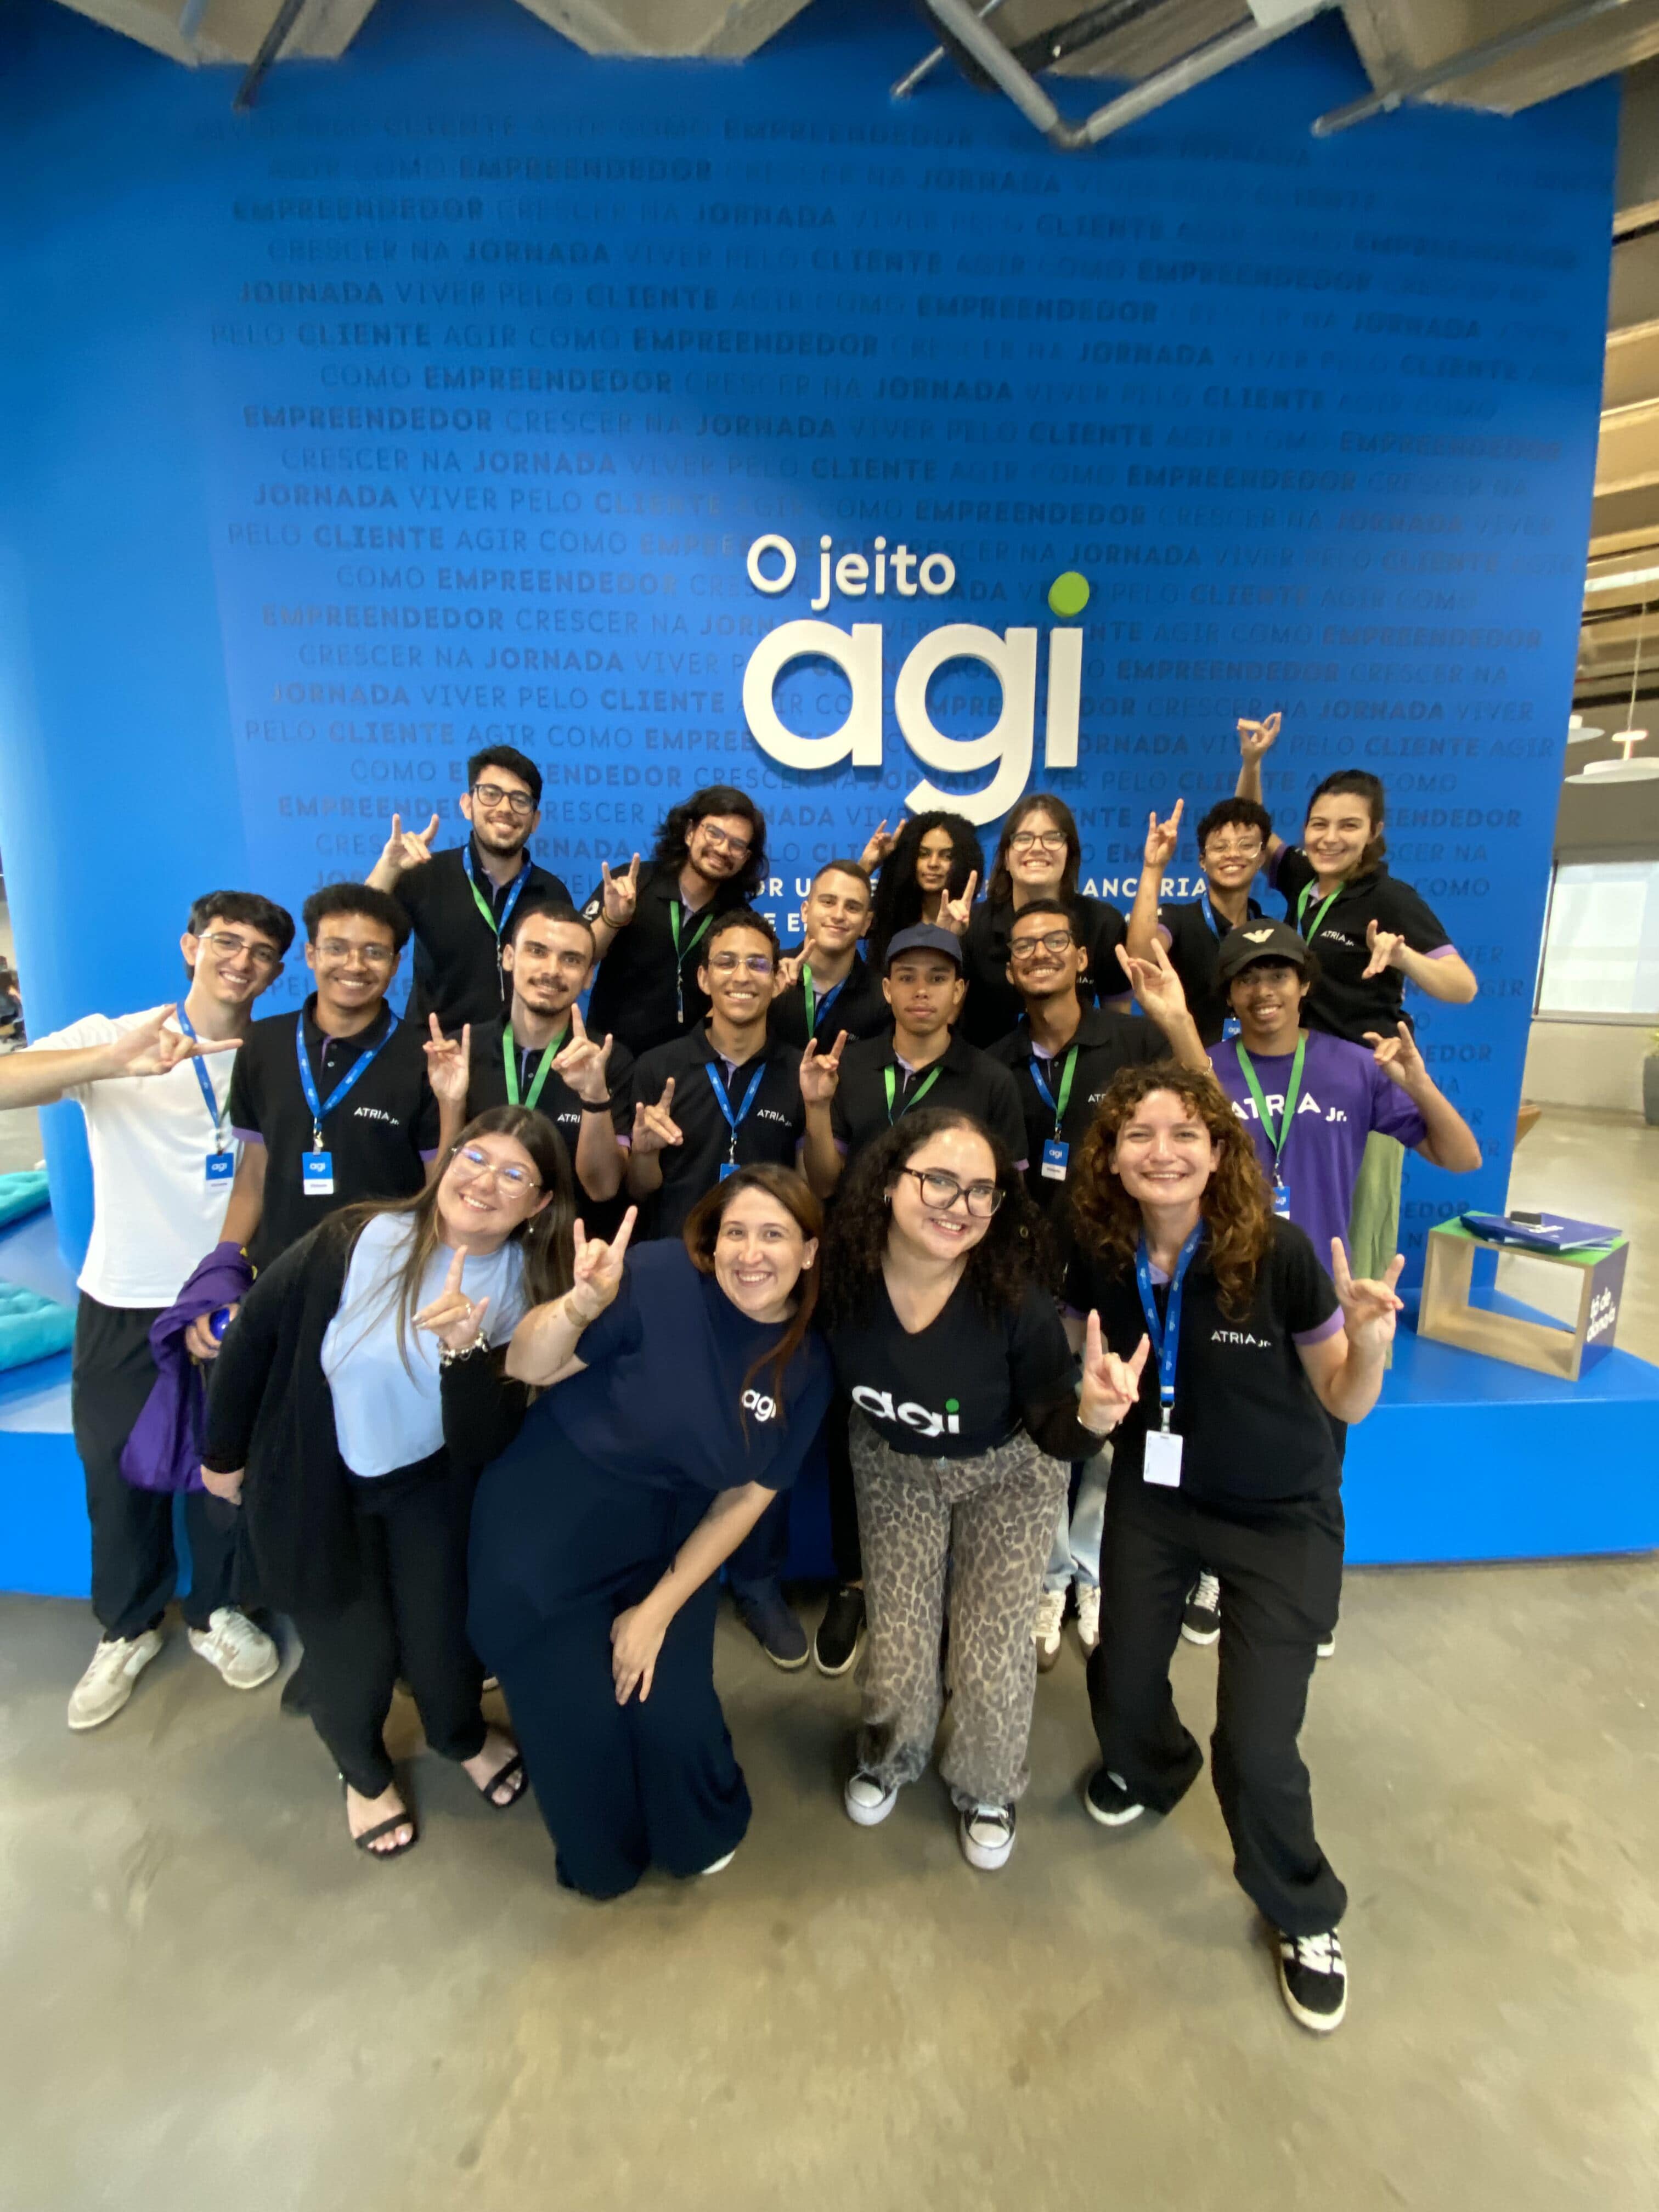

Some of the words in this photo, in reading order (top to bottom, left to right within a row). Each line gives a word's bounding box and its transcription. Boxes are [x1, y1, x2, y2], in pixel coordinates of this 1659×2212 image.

[724, 117, 973, 147] EMPREENDEDOR
[460, 156, 711, 182] EMPREENDEDOR
[919, 168, 1060, 195] JORNADA
[233, 197, 482, 222] EMPREENDEDOR
[699, 203, 836, 228] JORNADA
[1037, 214, 1163, 240] CLIENTE
[465, 240, 609, 265] JORNADA
[811, 248, 941, 273] CLIENTE
[1138, 259, 1372, 291] EMPREENDEDOR
[239, 281, 383, 304] JORNADA
[586, 284, 718, 311] CLIENTE
[918, 295, 1157, 323] EMPREENDEDOR
[298, 321, 431, 347] CLIENTE
[634, 328, 878, 356] EMPREENDEDOR
[1080, 342, 1214, 366] JORNADA
[321, 364, 410, 390] COMO
[425, 366, 671, 393] EMPREENDEDOR
[686, 372, 809, 396] CRESCER
[823, 377, 861, 399] NA
[878, 377, 1013, 403] JORNADA
[1025, 381, 1109, 404] VIVER
[1203, 387, 1324, 410] CLIENTE
[244, 406, 492, 431] EMPREENDEDOR
[506, 408, 632, 435] CRESCER
[646, 413, 681, 435] NA
[696, 414, 836, 438] JORNADA
[850, 417, 934, 439] VIVER
[948, 419, 1017, 444] PELO
[1029, 422, 1153, 447] CLIENTE
[1340, 432, 1561, 461] EMPREENDEDOR
[281, 447, 409, 472] CRESCER
[422, 450, 461, 471] NA
[473, 451, 617, 475] JORNADA
[629, 452, 714, 477] VIVER
[729, 453, 798, 479] PELO
[811, 457, 938, 481] CLIENTE
[950, 461, 1018, 483] AGIR
[1031, 464, 1115, 486] COMO
[1127, 466, 1356, 492] EMPREENDEDOR
[1368, 472, 1482, 496] CRESCER
[1493, 477, 1528, 499] NA
[254, 484, 398, 508] JORNADA
[410, 486, 497, 511] VIVER
[511, 488, 582, 515] PELO
[595, 489, 721, 516] CLIENTE
[738, 494, 805, 517] AGIR
[819, 496, 903, 521] COMO
[915, 500, 1146, 526] EMPREENDEDOR
[1159, 506, 1276, 528] CRESCER
[1288, 509, 1322, 531] NA
[1338, 511, 1463, 534] JORNADA
[1477, 514, 1554, 535] VIVER
[227, 523, 301, 546] PELO
[313, 525, 443, 551] CLIENTE
[456, 528, 527, 552] AGIR
[539, 529, 627, 555] COMO
[1020, 542, 1056, 564] NA
[1068, 544, 1202, 566] JORNADA
[1215, 546, 1294, 567] VIVER
[1306, 547, 1371, 572] PELO
[1382, 551, 1499, 574] CLIENTE
[336, 566, 424, 589] COMO
[439, 568, 676, 595] EMPREENDEDOR
[1113, 583, 1178, 604] PELO
[1190, 584, 1311, 606] CLIENTE
[1322, 586, 1385, 610] AGIR
[1396, 589, 1479, 610] COMO
[746, 533, 797, 594] O
[810, 534, 957, 612] jeito
[262, 604, 503, 630] EMPREENDEDOR
[516, 608, 637, 635] CRESCER
[652, 614, 688, 635] NA
[1153, 623, 1219, 644] AGIR
[1232, 624, 1313, 645] COMO
[1322, 626, 1542, 649] EMPREENDEDOR
[298, 644, 422, 668] CRESCER
[436, 647, 472, 668] NA
[484, 647, 624, 672] JORNADA
[636, 650, 719, 674] VIVER
[1118, 660, 1339, 682] EMPREENDEDOR
[1351, 663, 1463, 684] CRESCER
[1472, 665, 1509, 687] NA
[272, 682, 410, 706] JORNADA
[421, 684, 505, 708] VIVER
[519, 686, 588, 711] PELO
[601, 689, 725, 713] CLIENTE
[816, 693, 896, 715] COO
[1147, 697, 1261, 720] CRESCER
[1273, 699, 1307, 721] NA
[1318, 700, 1444, 721] JORNADA
[1456, 701, 1534, 722] VIVER
[742, 571, 1090, 827] agi
[246, 720, 316, 743] PELO
[329, 721, 454, 744] CLIENTE
[466, 724, 535, 747] AGIR
[549, 725, 633, 749] COMO
[1079, 733, 1189, 755] ORNADA
[1290, 736, 1355, 755] PELO
[1365, 736, 1480, 757] CLIENTE
[1489, 738, 1554, 758] AGIR
[350, 759, 436, 782] COMO
[693, 767, 813, 790] CRESCER
[1102, 771, 1167, 793] PELO
[543, 801, 644, 824] RESCER
[1454, 843, 1488, 865] NA
[1319, 929, 1345, 943] ATRIA
[354, 1107, 389, 1121] ATRIA
[757, 1109, 785, 1122] ATRIA
[1232, 1092, 1321, 1120] ATRA
[1325, 1108, 1347, 1122] Jr.
[211, 1163, 228, 1172] agi
[309, 1163, 325, 1172] agi
[1049, 1149, 1062, 1159] agi
[1211, 1330, 1256, 1344] ATRIA
[852, 1385, 960, 1437] agi
